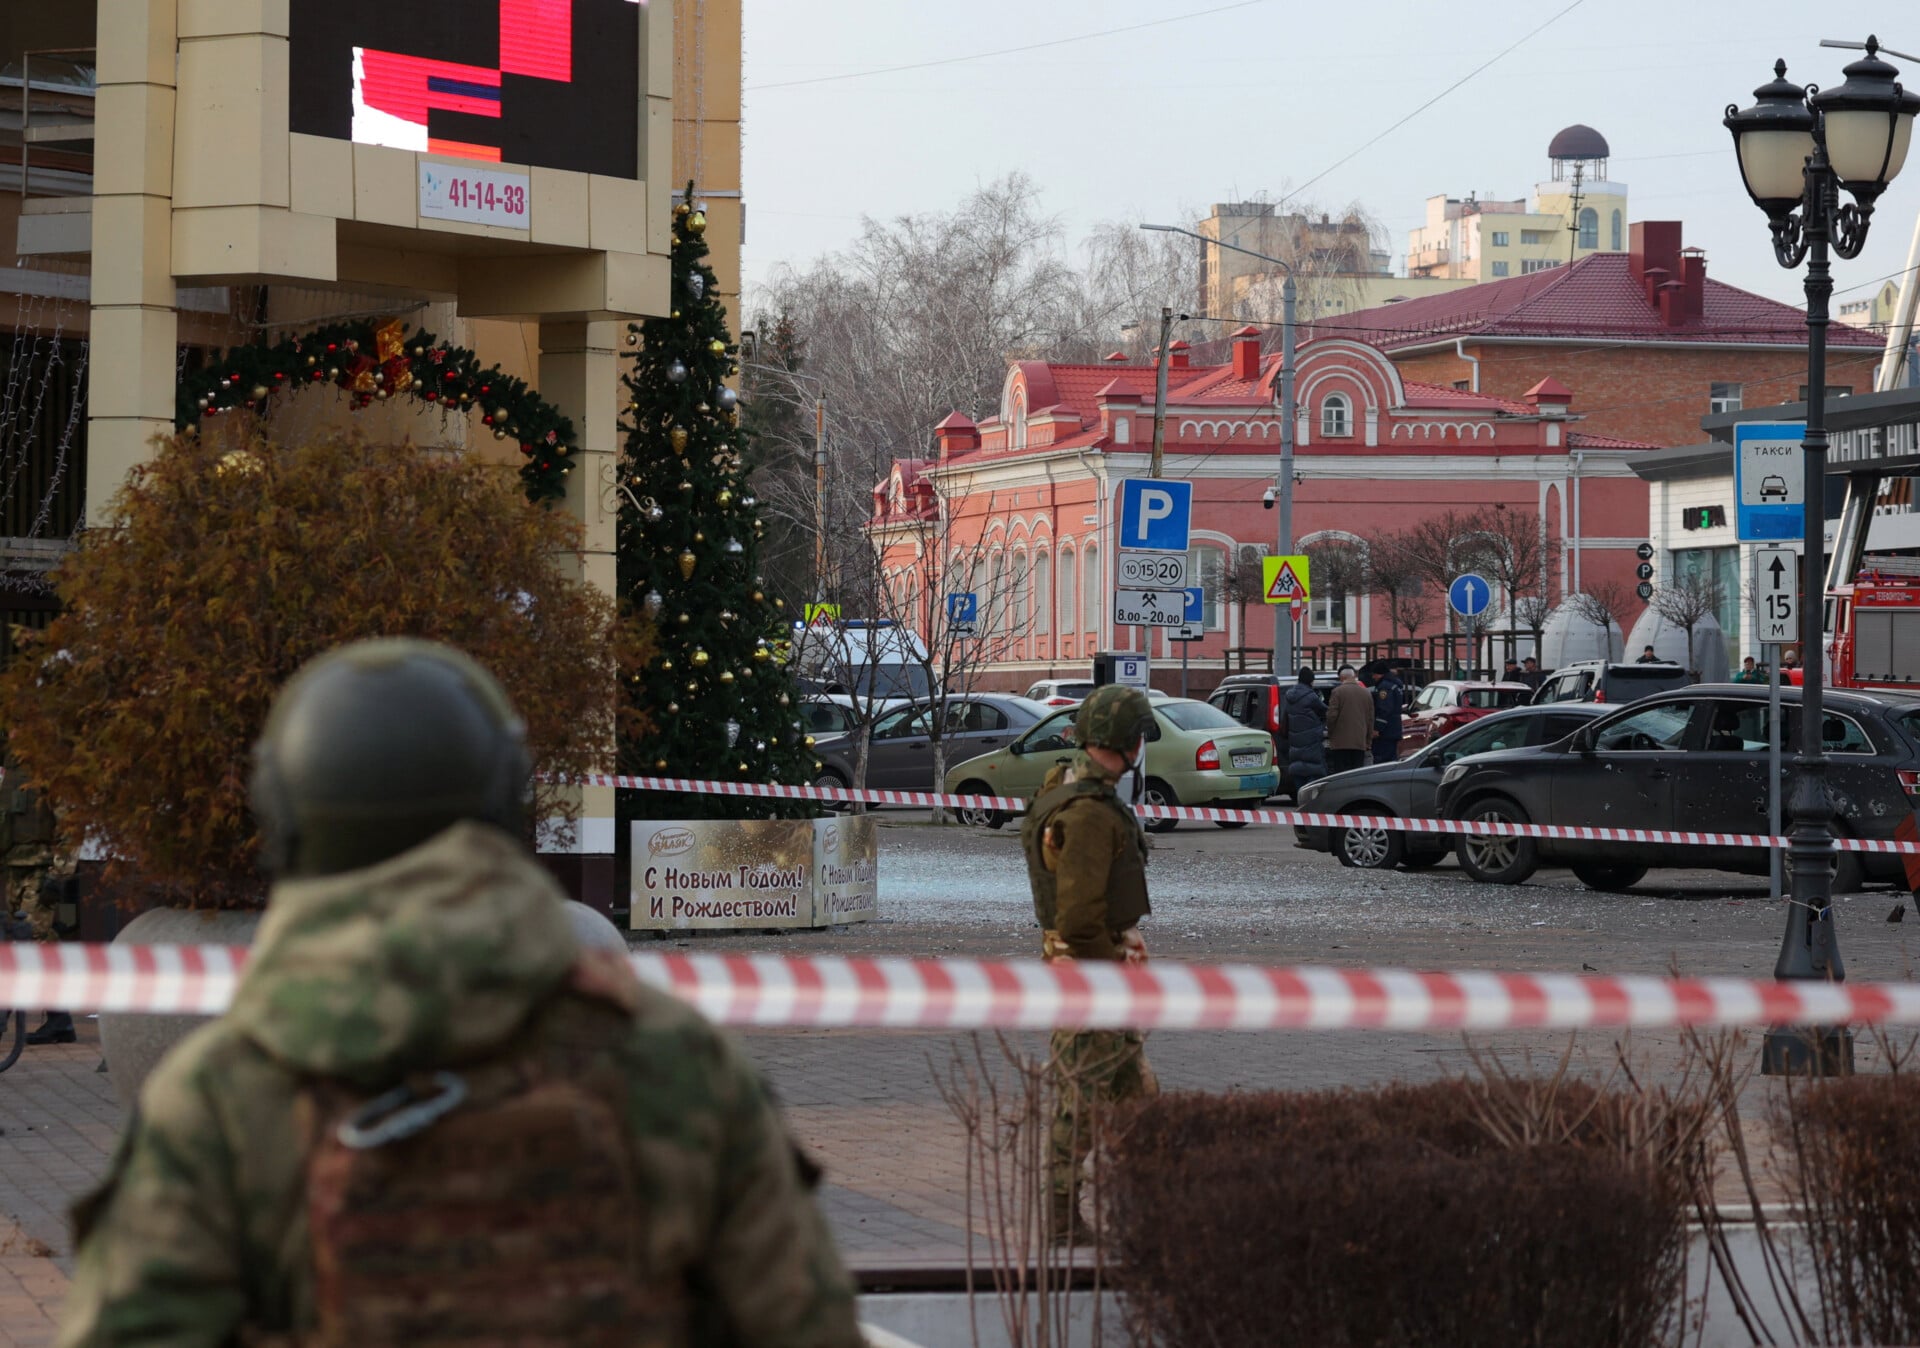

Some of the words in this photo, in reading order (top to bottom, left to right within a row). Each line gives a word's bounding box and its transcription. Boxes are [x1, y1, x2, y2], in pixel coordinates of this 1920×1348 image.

[449, 178, 524, 214] 41-14-33
[1754, 446, 1792, 456] ТАКСИ
[1826, 427, 1882, 464] WHITE
[1137, 488, 1174, 540] P
[1126, 565, 1137, 575] 10
[1141, 564, 1154, 576] 15
[1158, 563, 1179, 578] 20
[1641, 564, 1651, 578] P
[1766, 594, 1791, 620] 15
[645, 867, 657, 890] С
[665, 867, 732, 889] Новым
[739, 864, 804, 889] Годом!
[821, 864, 827, 886] С
[650, 896, 664, 919] И
[672, 895, 797, 918] Рождеством!
